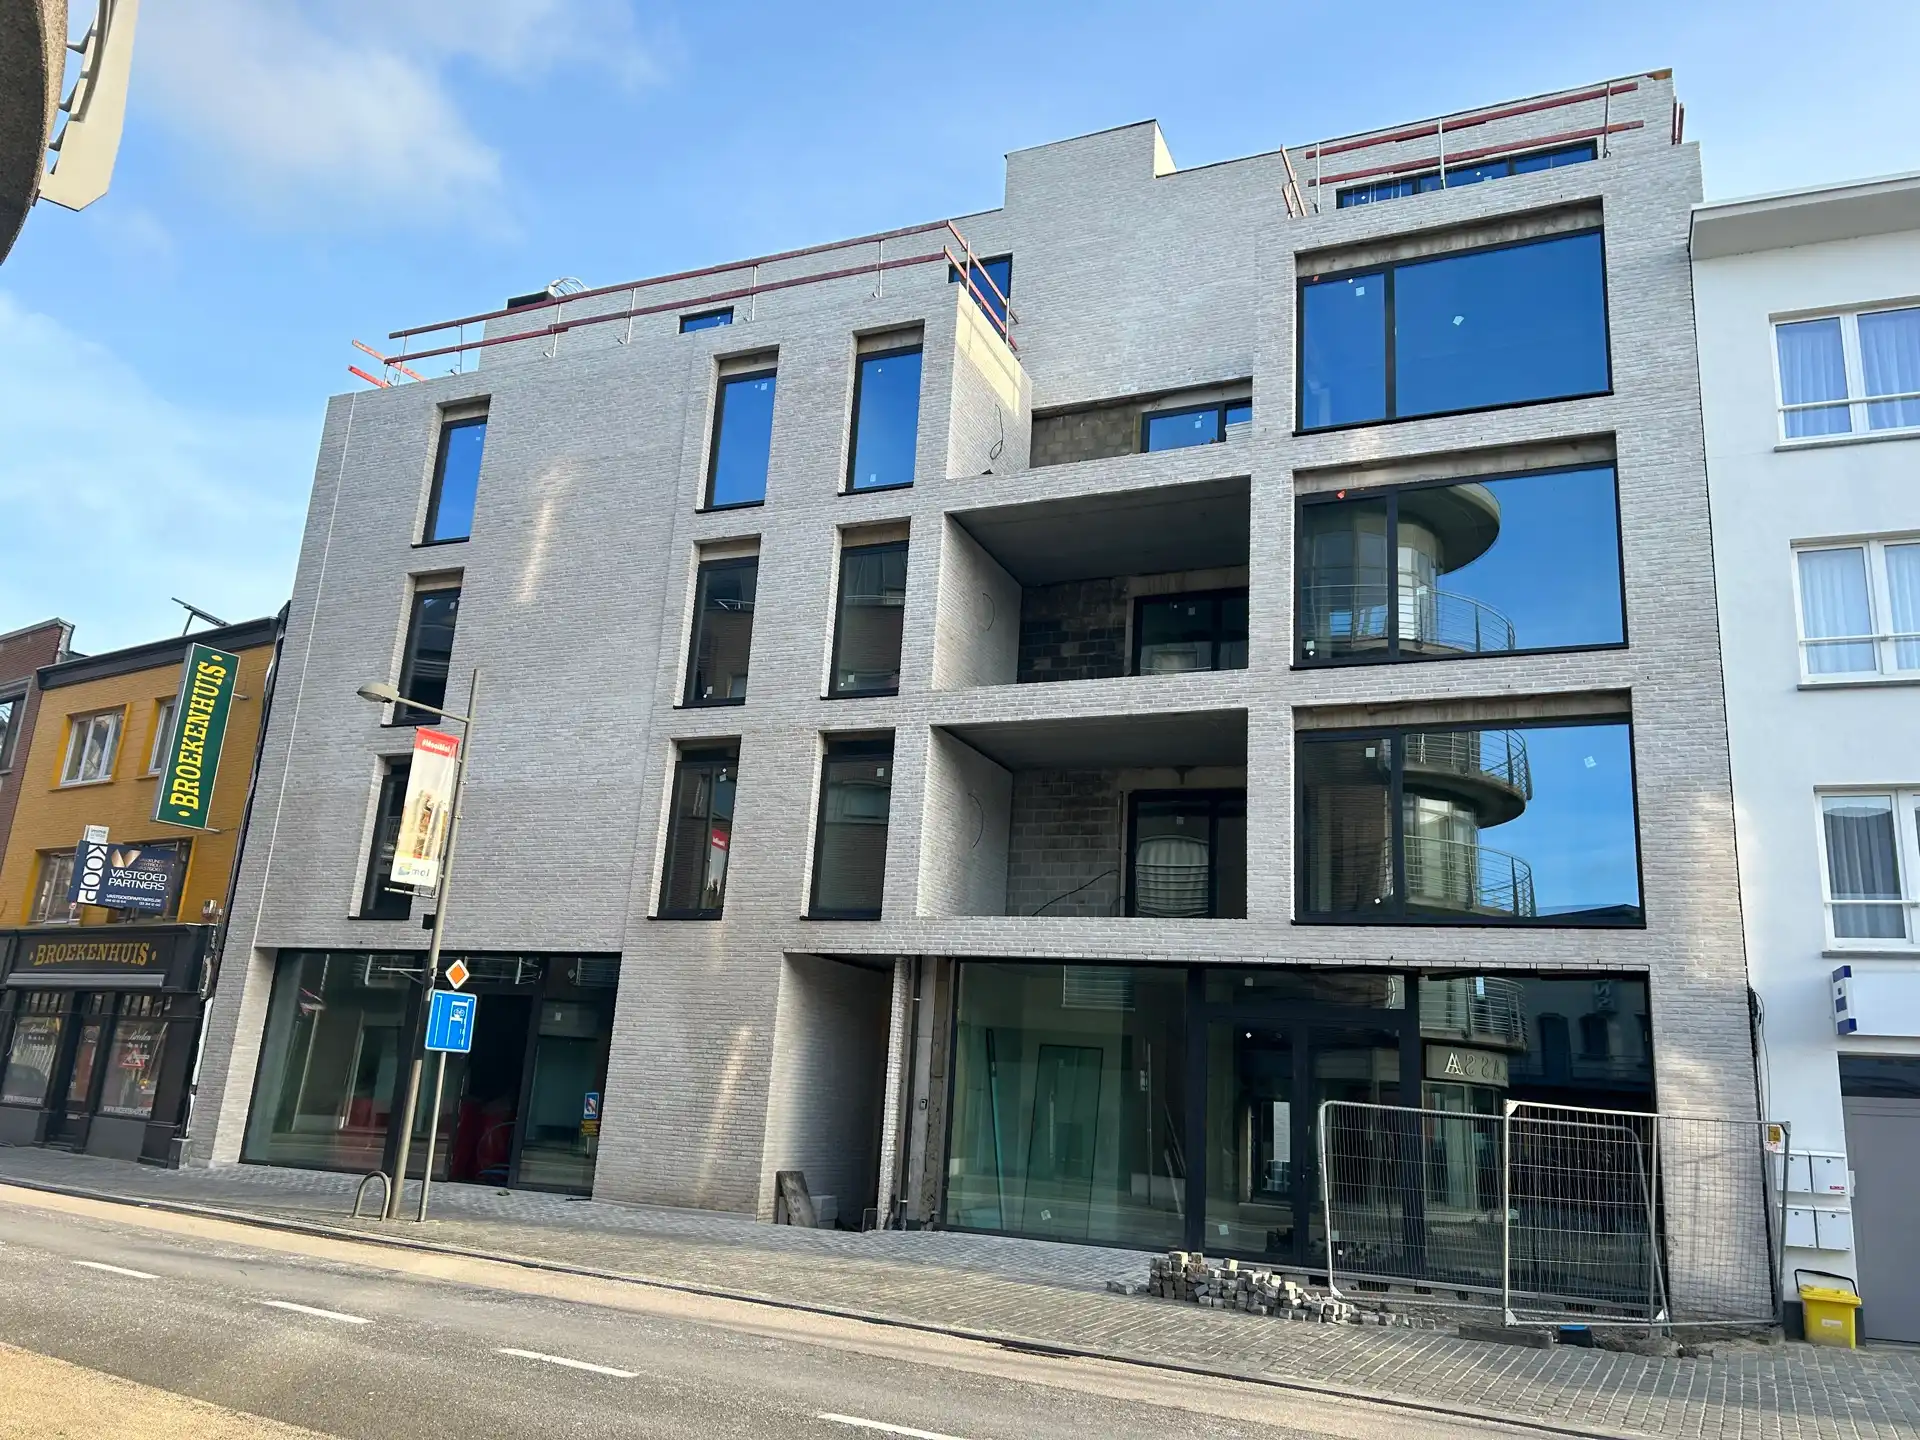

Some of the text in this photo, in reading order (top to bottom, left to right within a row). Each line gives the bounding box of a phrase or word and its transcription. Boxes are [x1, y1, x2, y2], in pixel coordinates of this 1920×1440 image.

[169, 660, 227, 810] BROEKENHUIS
[79, 842, 109, 902] KOOP
[108, 877, 165, 891] PARTNERS
[110, 868, 168, 882] VASTGOED
[33, 942, 150, 966] BROEKENHUIS
